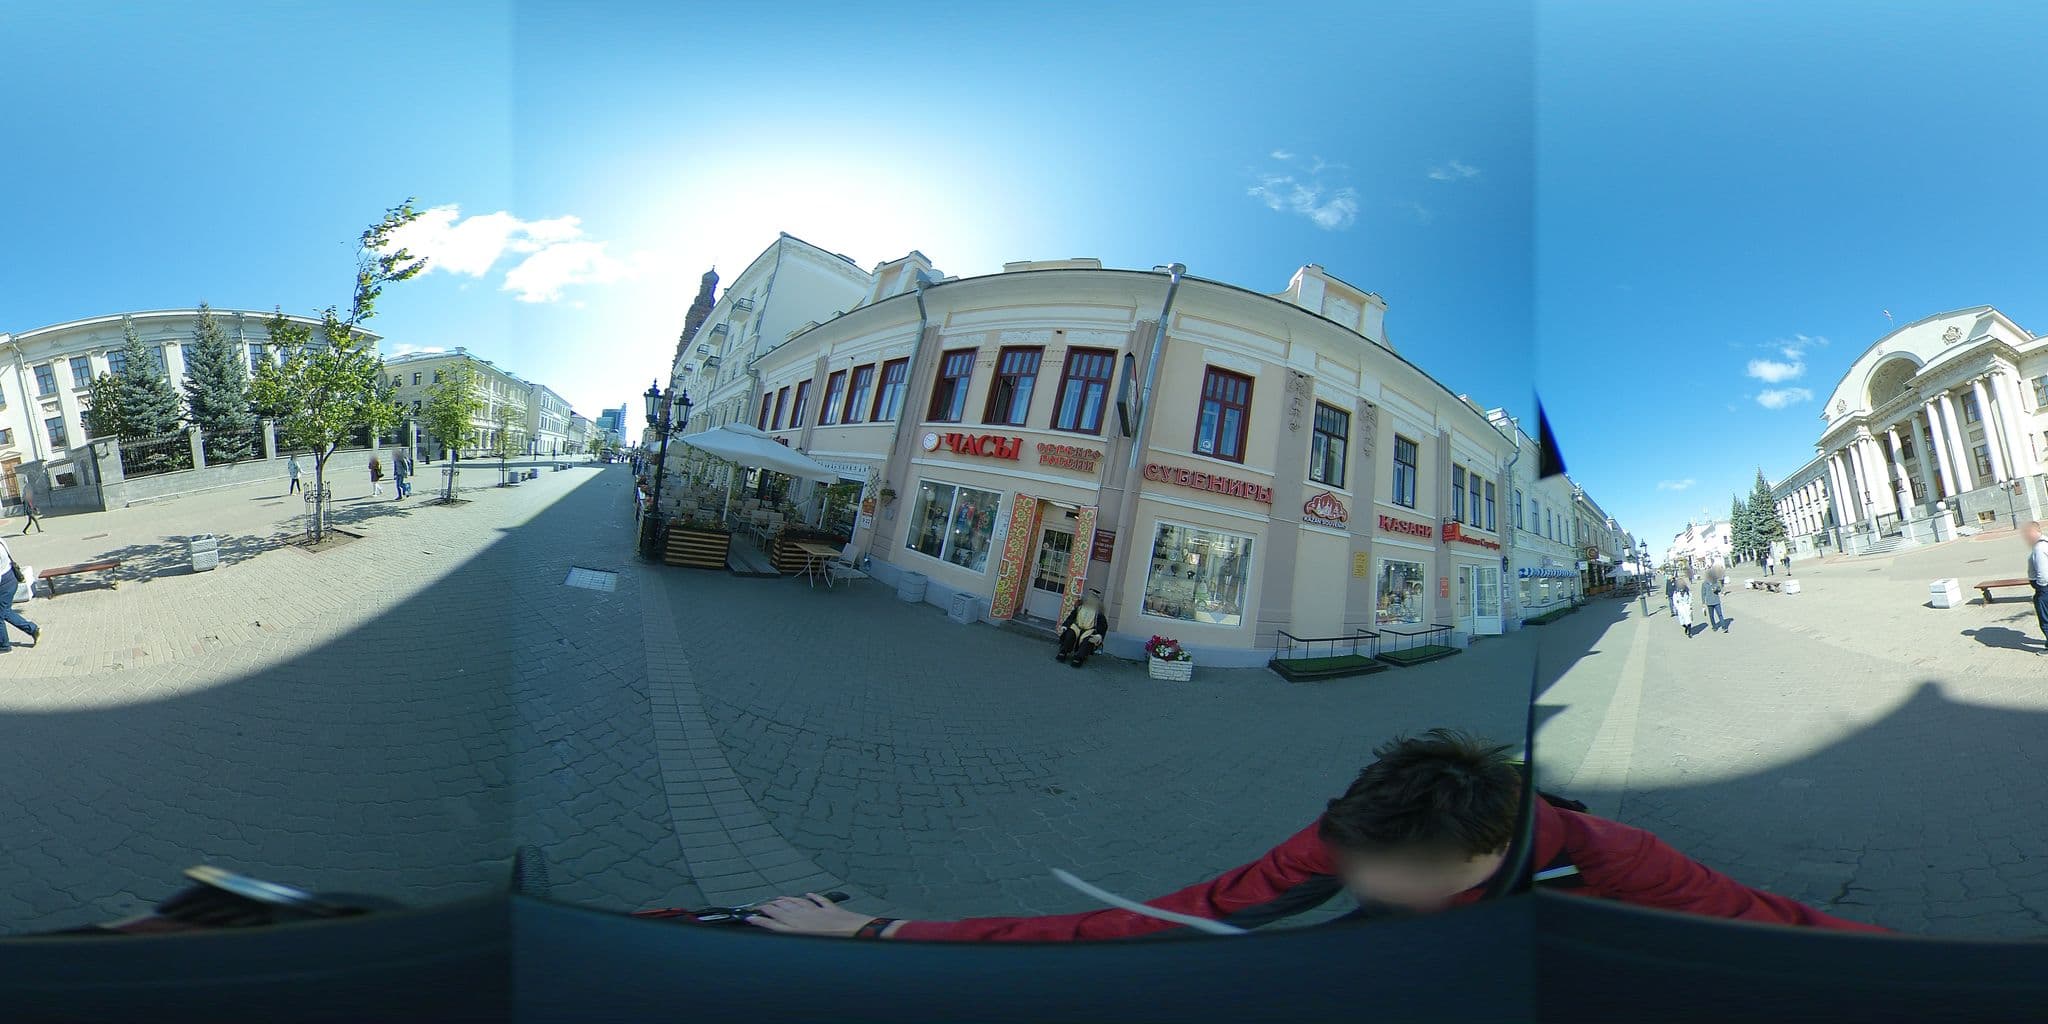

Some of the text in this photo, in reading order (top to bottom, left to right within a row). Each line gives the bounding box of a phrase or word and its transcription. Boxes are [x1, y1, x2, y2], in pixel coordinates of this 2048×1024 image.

[945, 433, 1024, 461] ЧАСЫ
[1037, 443, 1102, 459] СЕРЕБРО
[1143, 463, 1273, 504] СУВЕНИРЫ
[1379, 514, 1433, 538] КАЗАНИ
